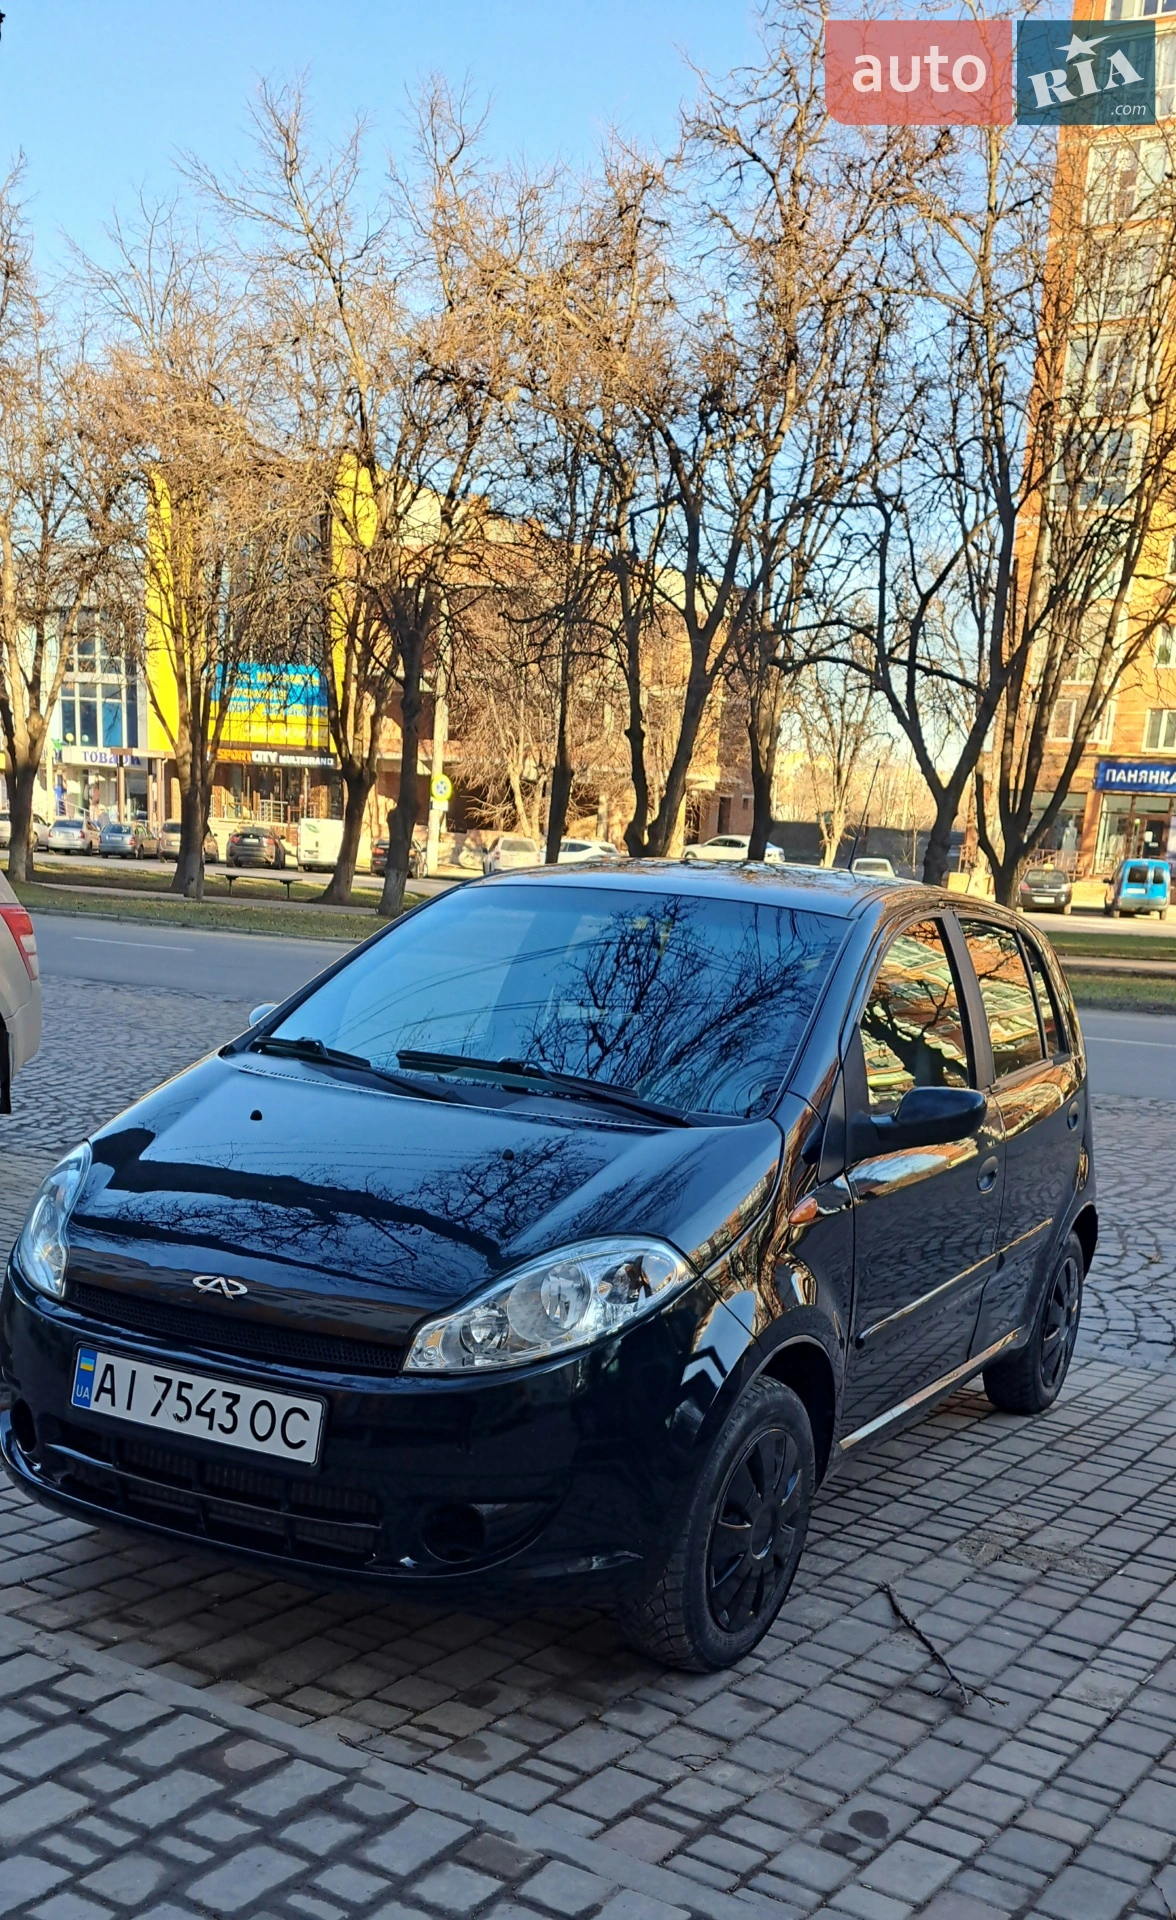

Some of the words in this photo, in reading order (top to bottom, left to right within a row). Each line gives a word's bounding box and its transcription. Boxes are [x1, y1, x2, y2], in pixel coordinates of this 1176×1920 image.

[279, 755, 334, 766] MULTIBRAND
[75, 1385, 90, 1400] UA
[94, 1363, 136, 1411] AI
[150, 1375, 241, 1435] 7543
[249, 1399, 310, 1450] OC
